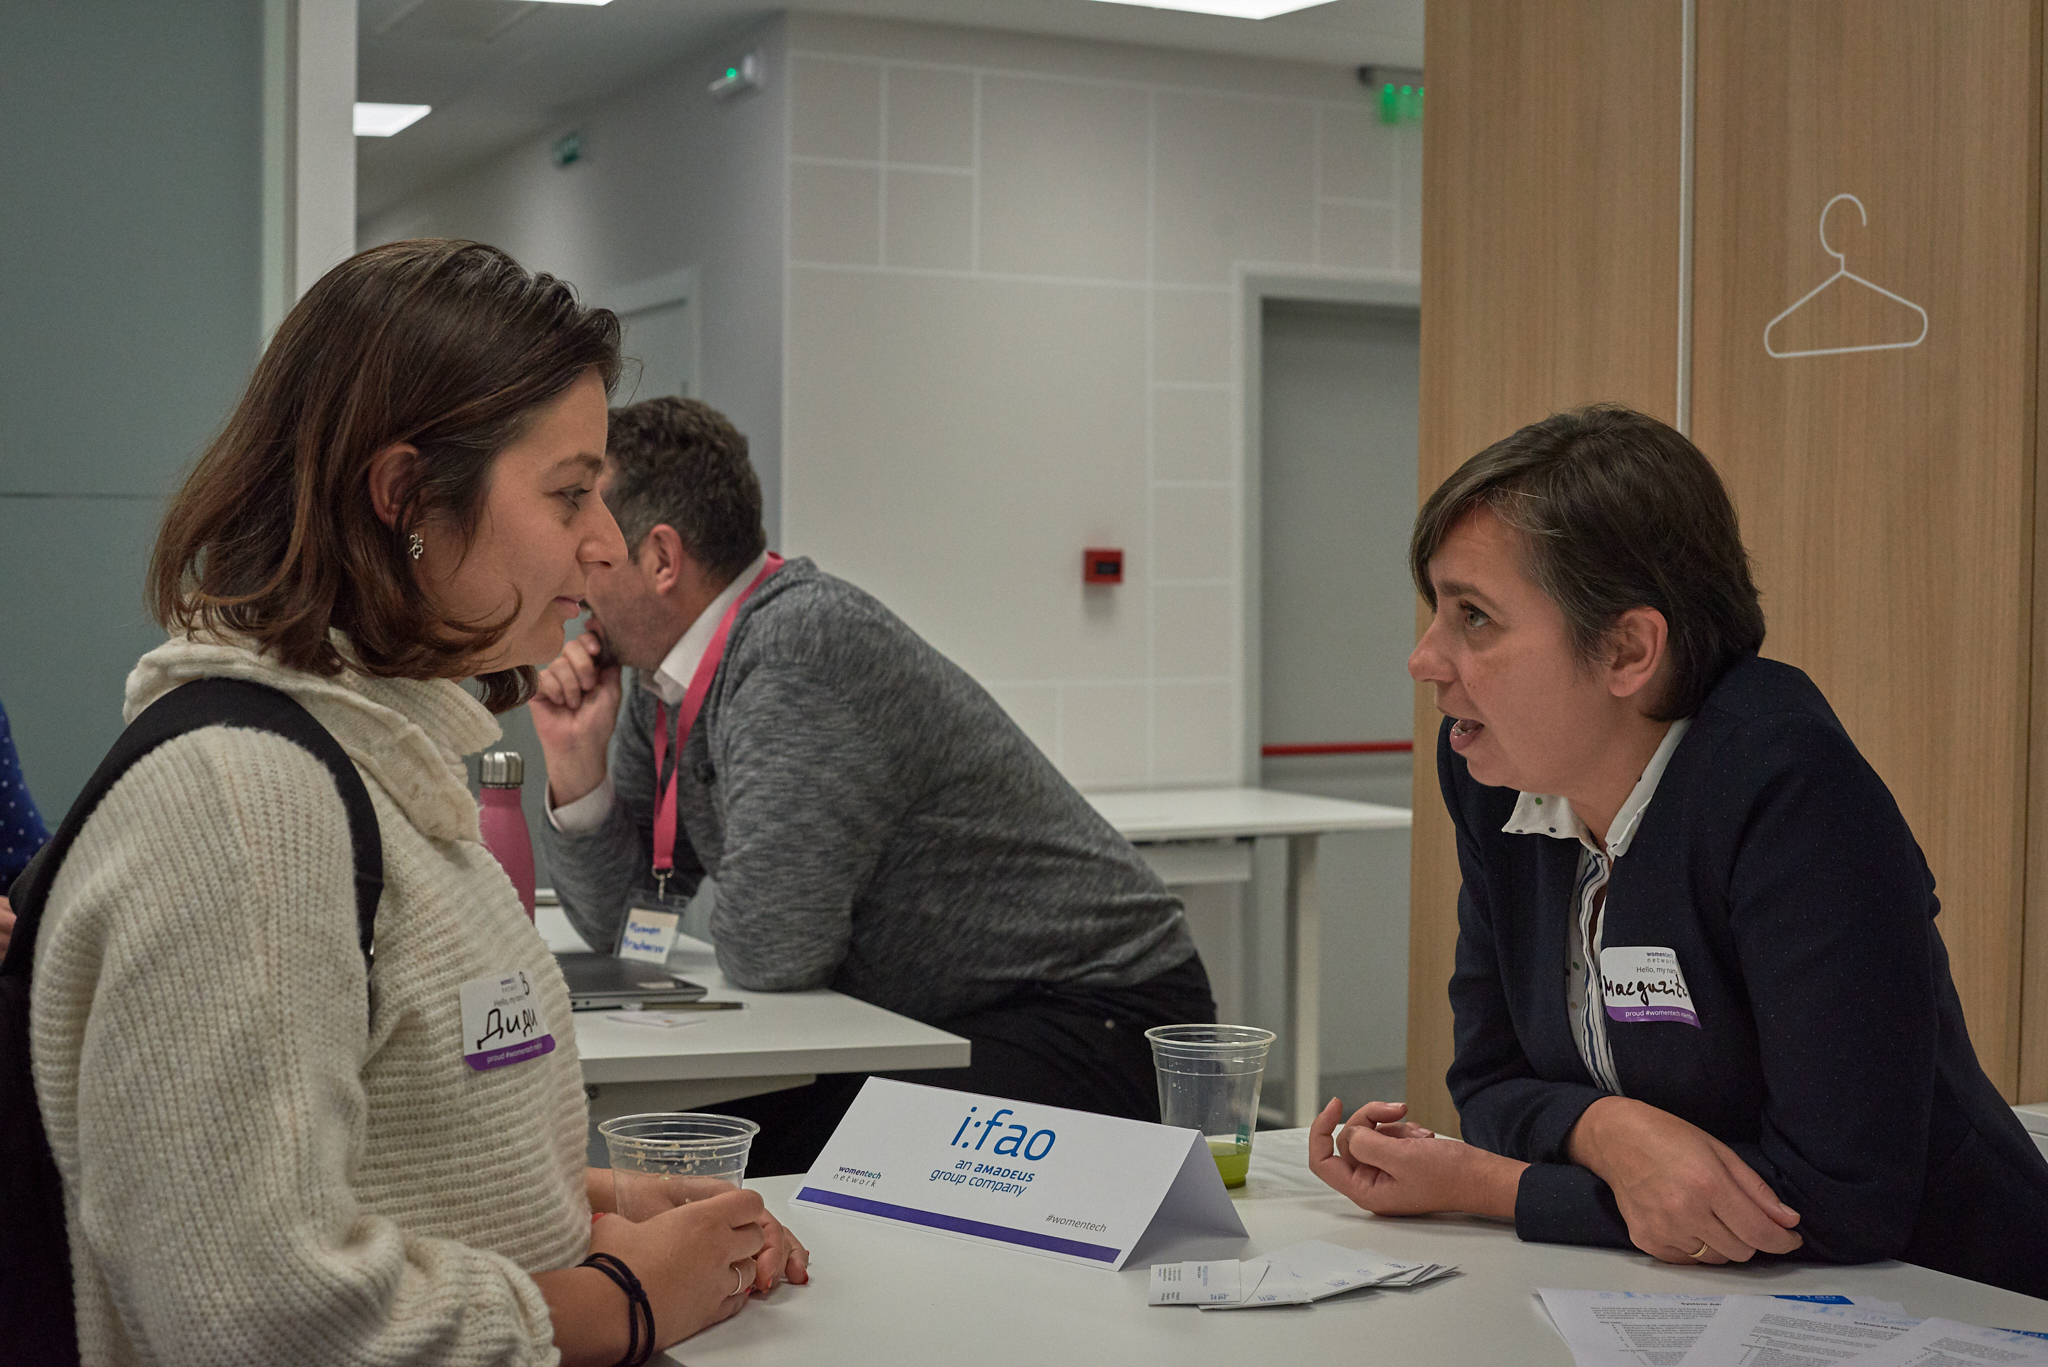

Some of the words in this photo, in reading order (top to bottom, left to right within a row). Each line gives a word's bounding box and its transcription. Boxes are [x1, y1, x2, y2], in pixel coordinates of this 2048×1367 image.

[1636, 966, 1656, 974] Hello,
[1625, 1010, 1645, 1018] proud
[838, 1165, 882, 1180] womentech
[954, 1159, 973, 1171] an
[832, 1172, 877, 1188] network
[929, 1168, 967, 1186] group
[968, 1175, 1028, 1198] company
[1045, 1213, 1107, 1233] #womentech
